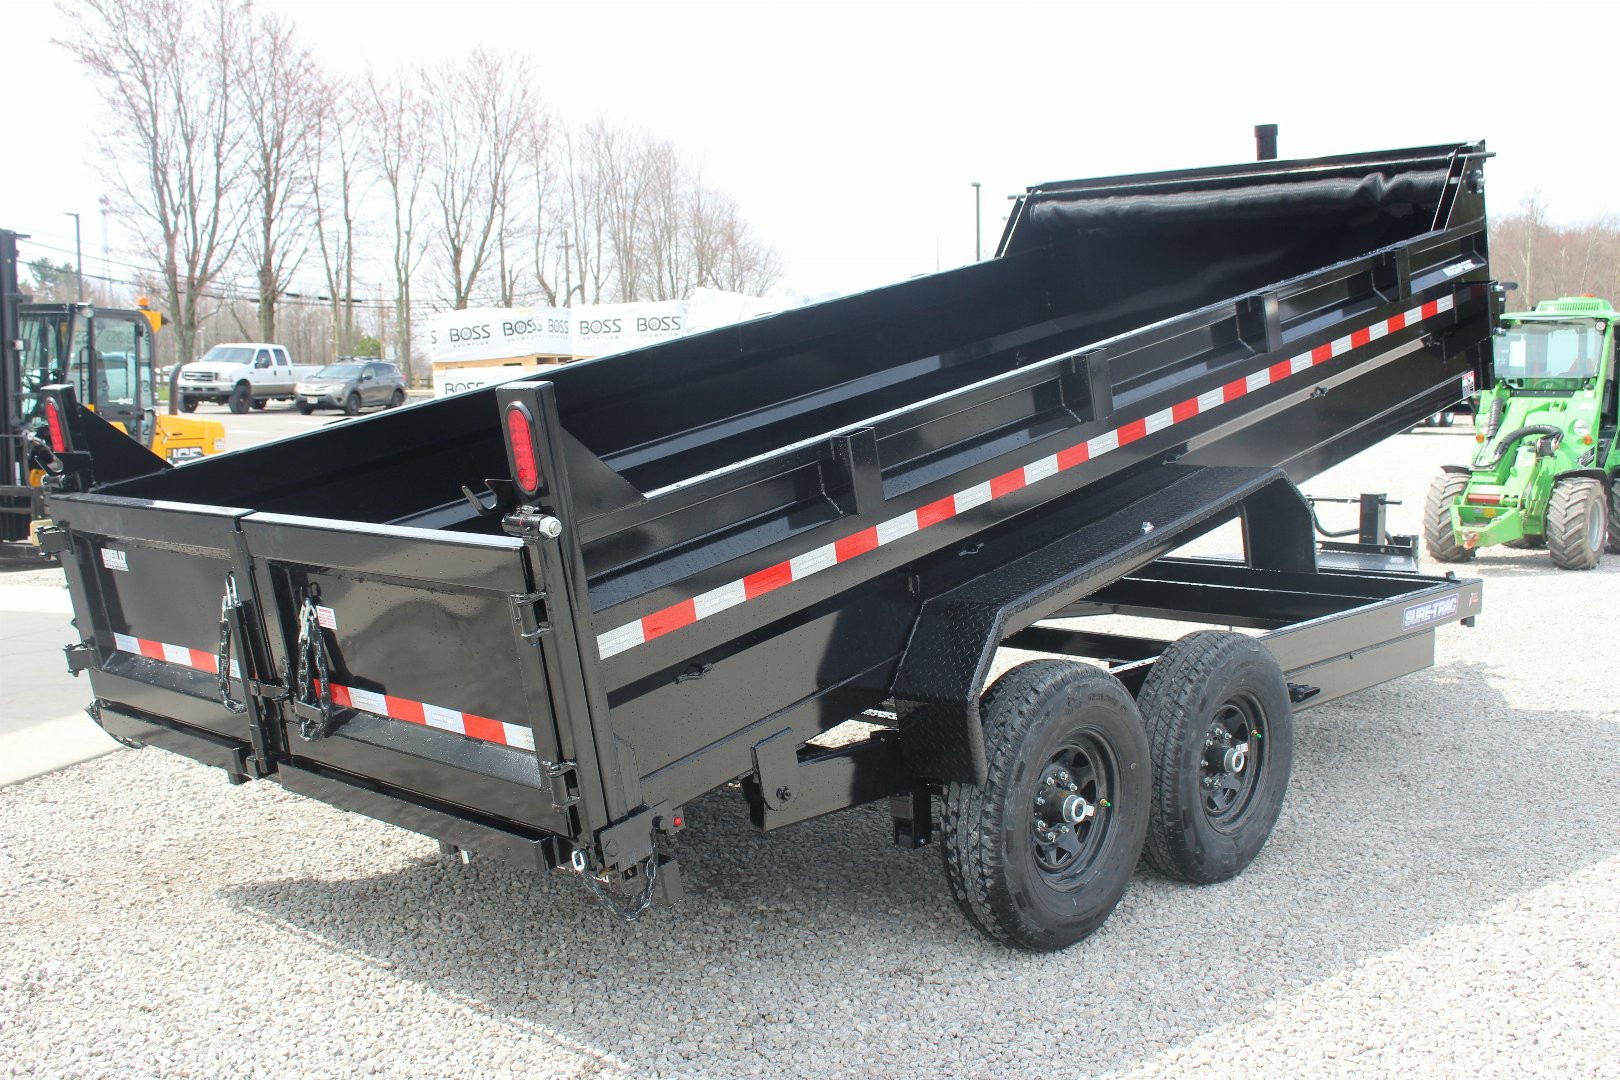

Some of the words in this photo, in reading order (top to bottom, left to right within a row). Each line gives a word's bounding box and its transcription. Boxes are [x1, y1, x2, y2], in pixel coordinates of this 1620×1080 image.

[548, 318, 569, 335] BOSS
[579, 318, 622, 335] BOSS
[636, 316, 681, 332] BOSS
[449, 324, 491, 343] BOSS
[1404, 597, 1457, 627] SURE-TRAC
